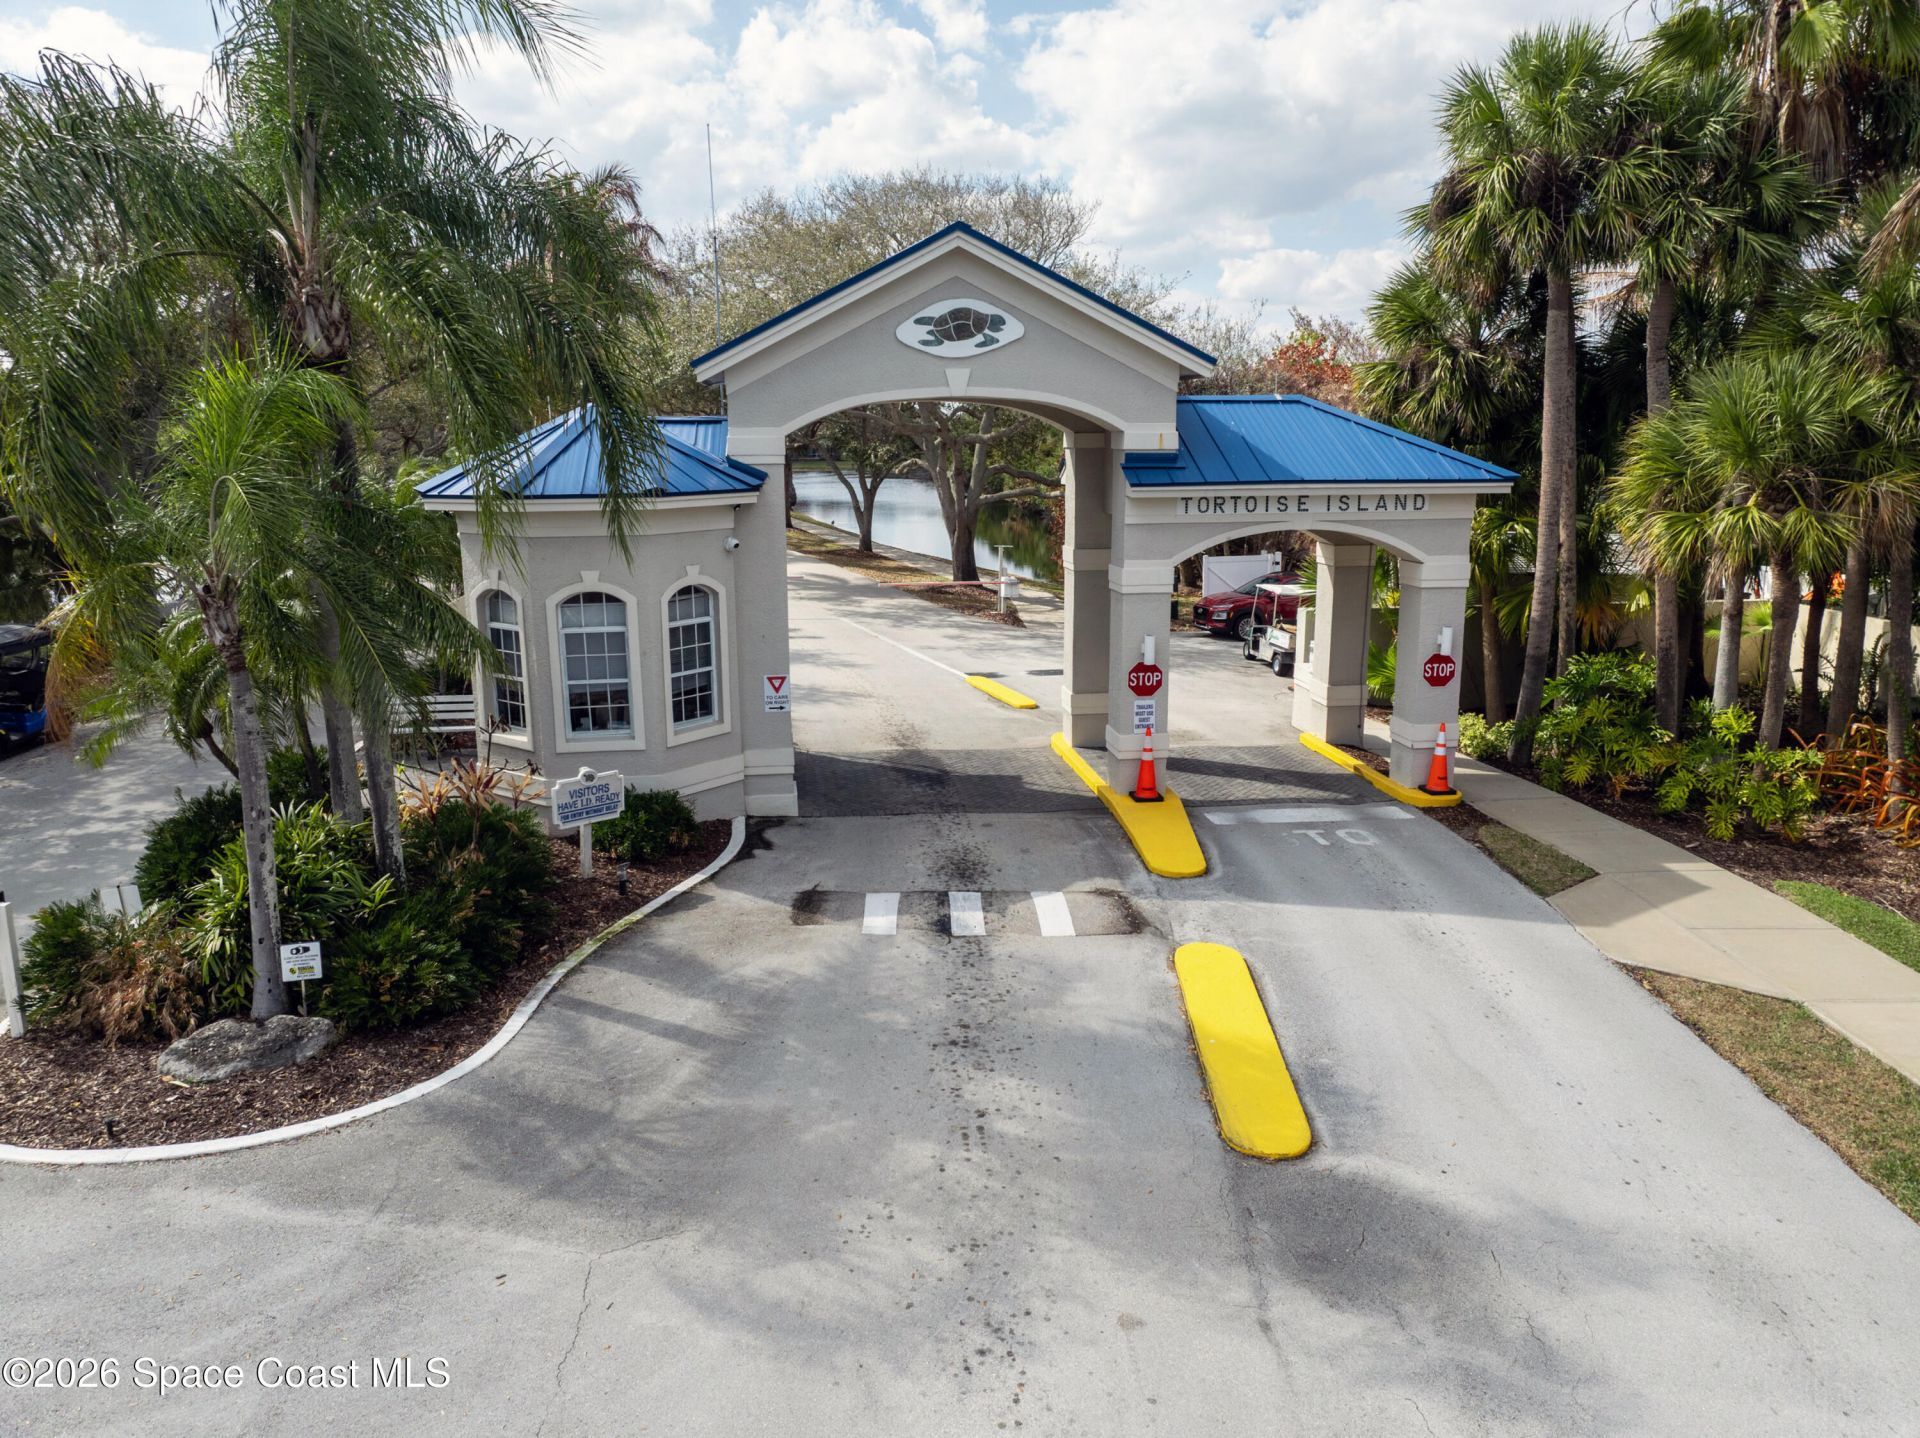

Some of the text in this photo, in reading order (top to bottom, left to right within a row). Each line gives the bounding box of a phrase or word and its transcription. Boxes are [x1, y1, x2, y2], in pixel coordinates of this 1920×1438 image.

[1180, 494, 1426, 514] TORTOISE ISLAND
[1425, 664, 1454, 676] STOP
[1130, 673, 1161, 686] STOP
[569, 783, 610, 800] VISITORS
[557, 800, 579, 812] HAVE
[595, 792, 620, 804] READY
